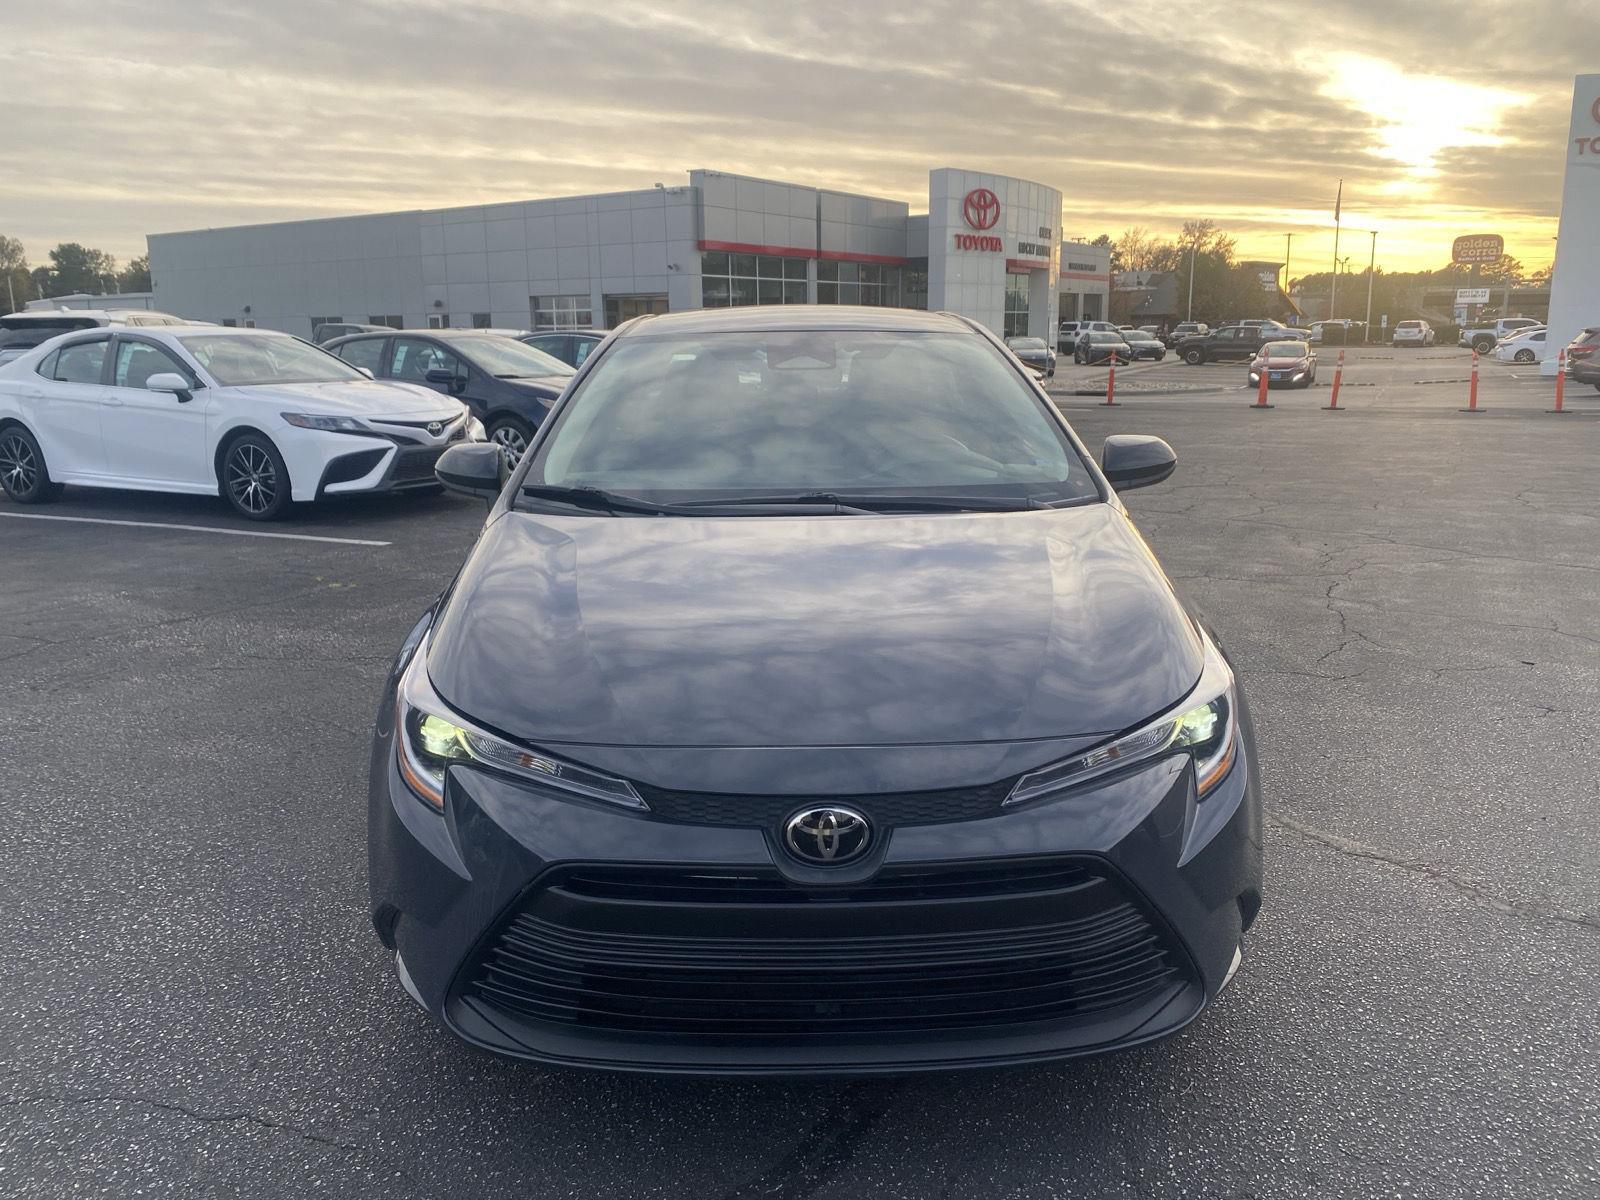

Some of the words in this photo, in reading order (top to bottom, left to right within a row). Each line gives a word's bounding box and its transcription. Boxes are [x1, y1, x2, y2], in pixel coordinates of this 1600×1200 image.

[955, 234, 1002, 252] TOYOTA
[1455, 239, 1498, 251] golden
[1460, 246, 1502, 256] corral
